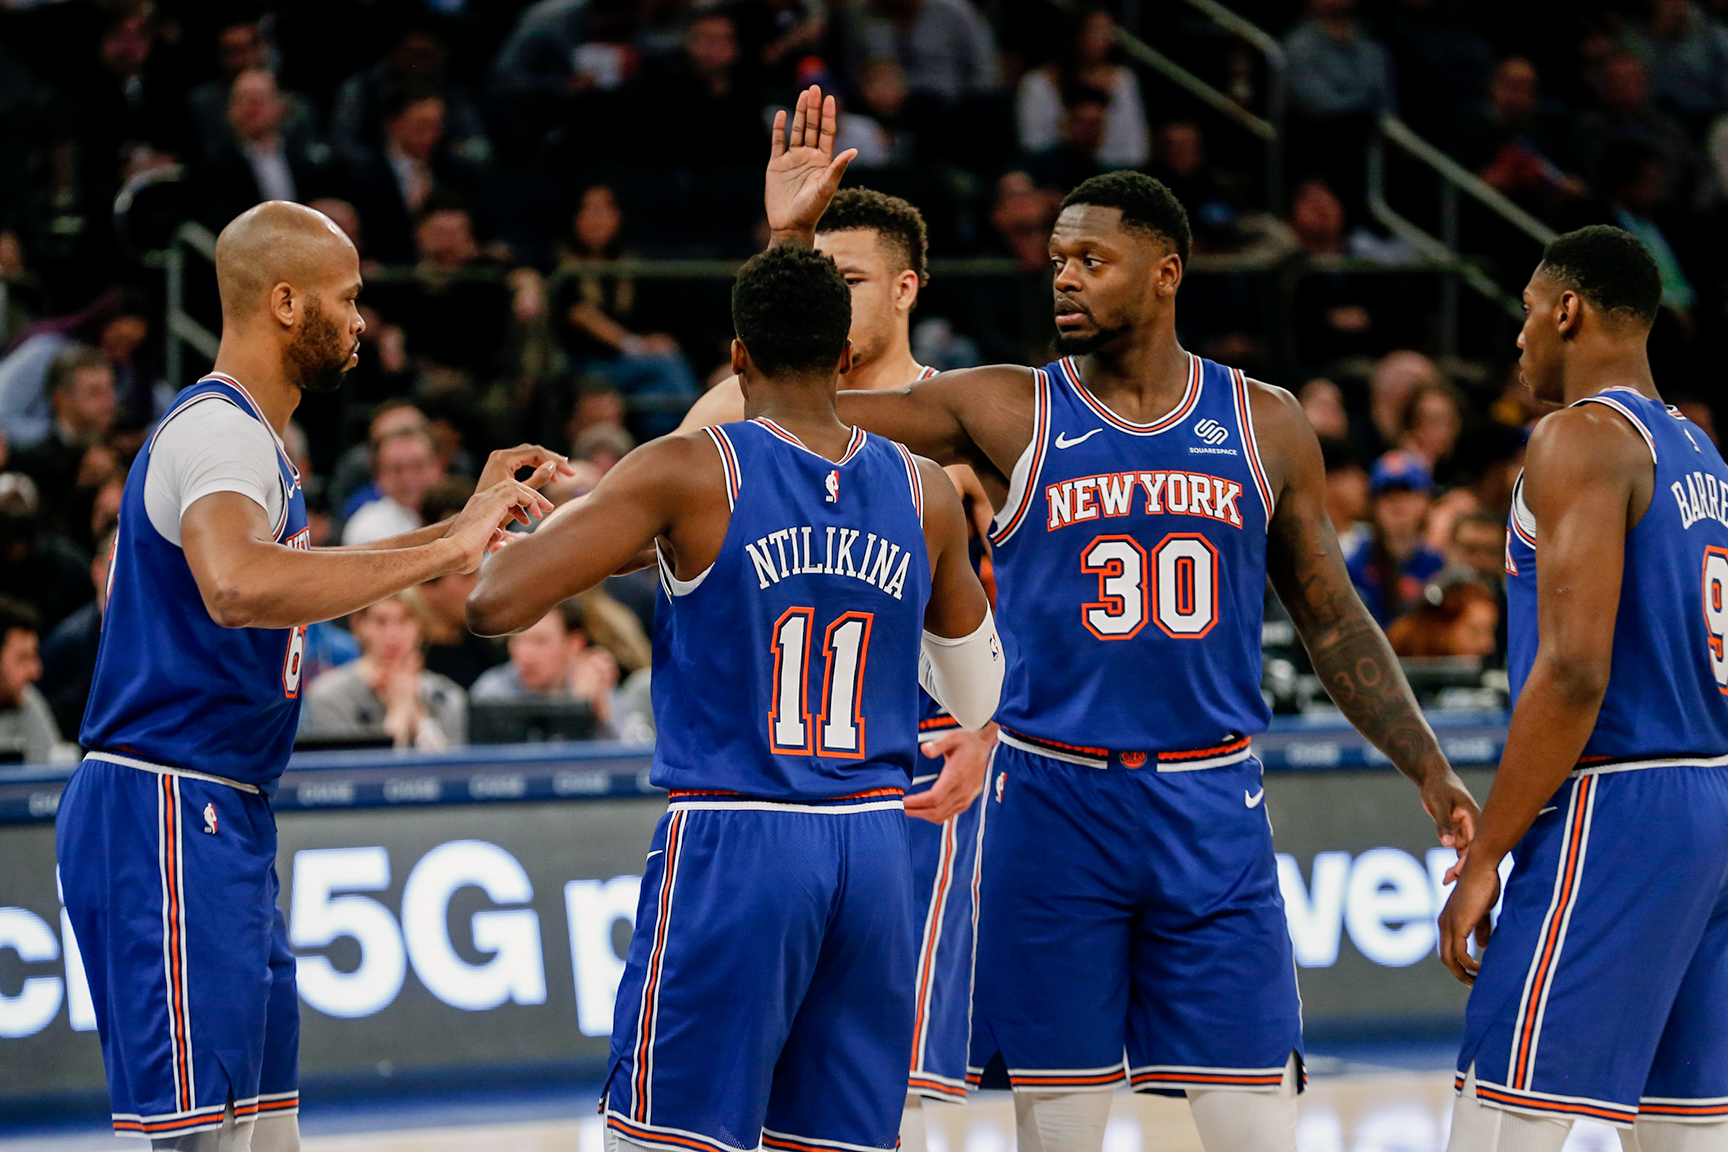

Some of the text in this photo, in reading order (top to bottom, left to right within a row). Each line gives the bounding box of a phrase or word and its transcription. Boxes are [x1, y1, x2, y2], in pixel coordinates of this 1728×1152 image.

[1189, 447, 1237, 456] SQUARESPACE
[1046, 470, 1243, 532] NEW YORK
[745, 526, 911, 600] NTILIKINA
[1081, 532, 1219, 640] 30
[768, 606, 874, 759] 11
[1333, 657, 1381, 699] 30
[289, 840, 547, 1018] 5G
